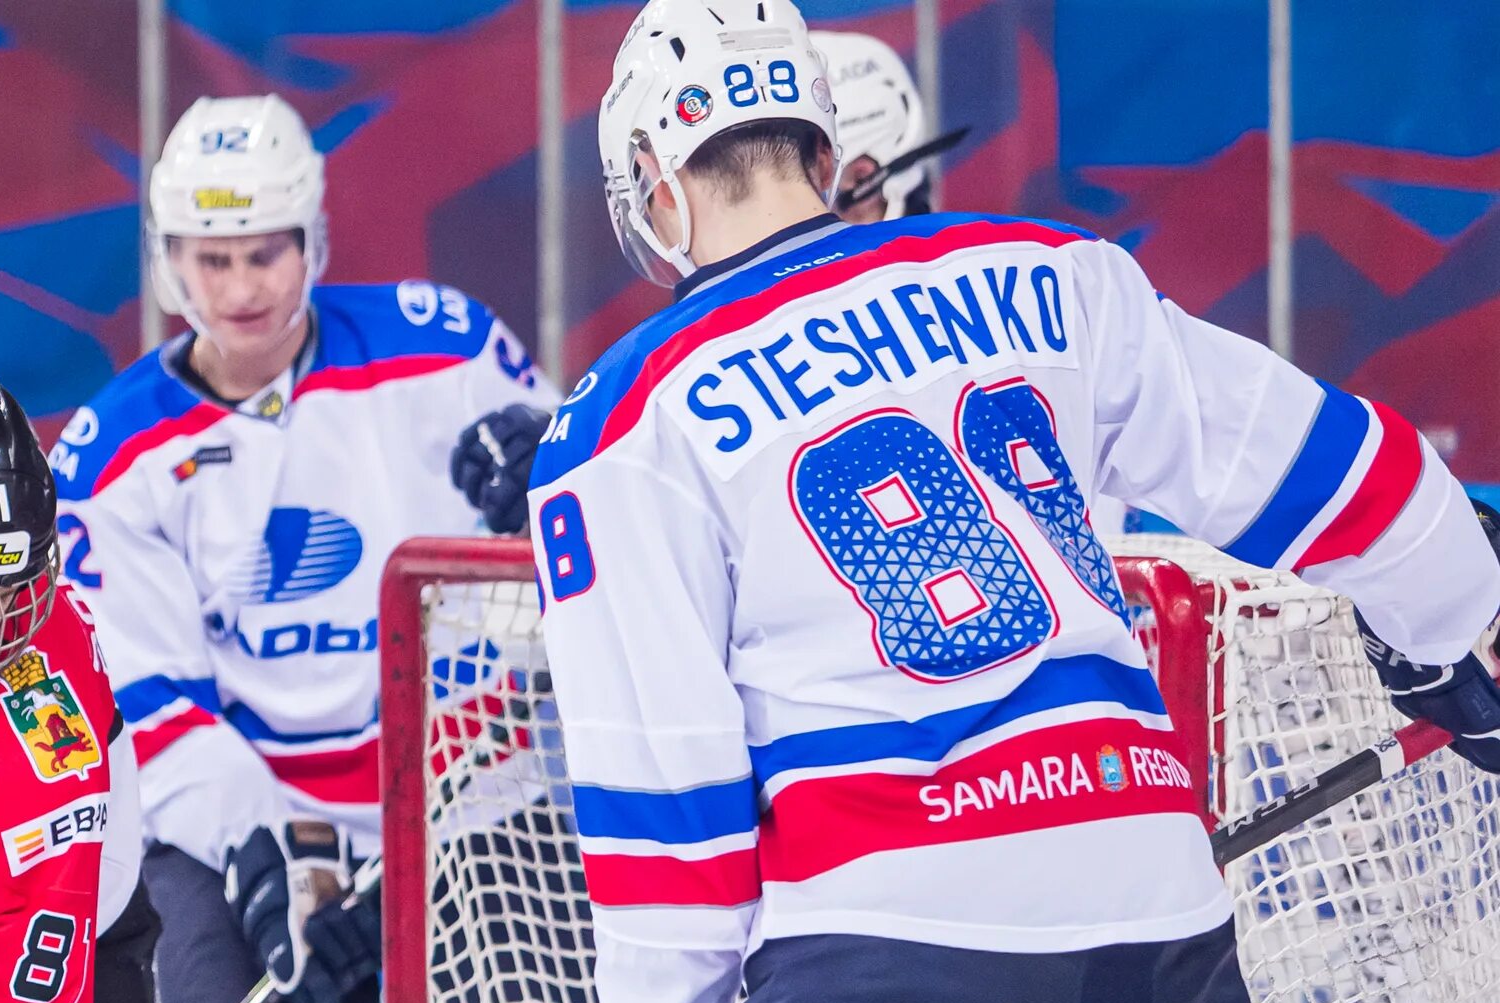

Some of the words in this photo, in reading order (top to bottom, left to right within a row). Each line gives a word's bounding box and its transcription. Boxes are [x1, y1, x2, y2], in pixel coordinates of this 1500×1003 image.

[202, 127, 249, 154] 92
[687, 264, 1068, 453] STESHENKO
[919, 752, 1094, 822] SAMARA
